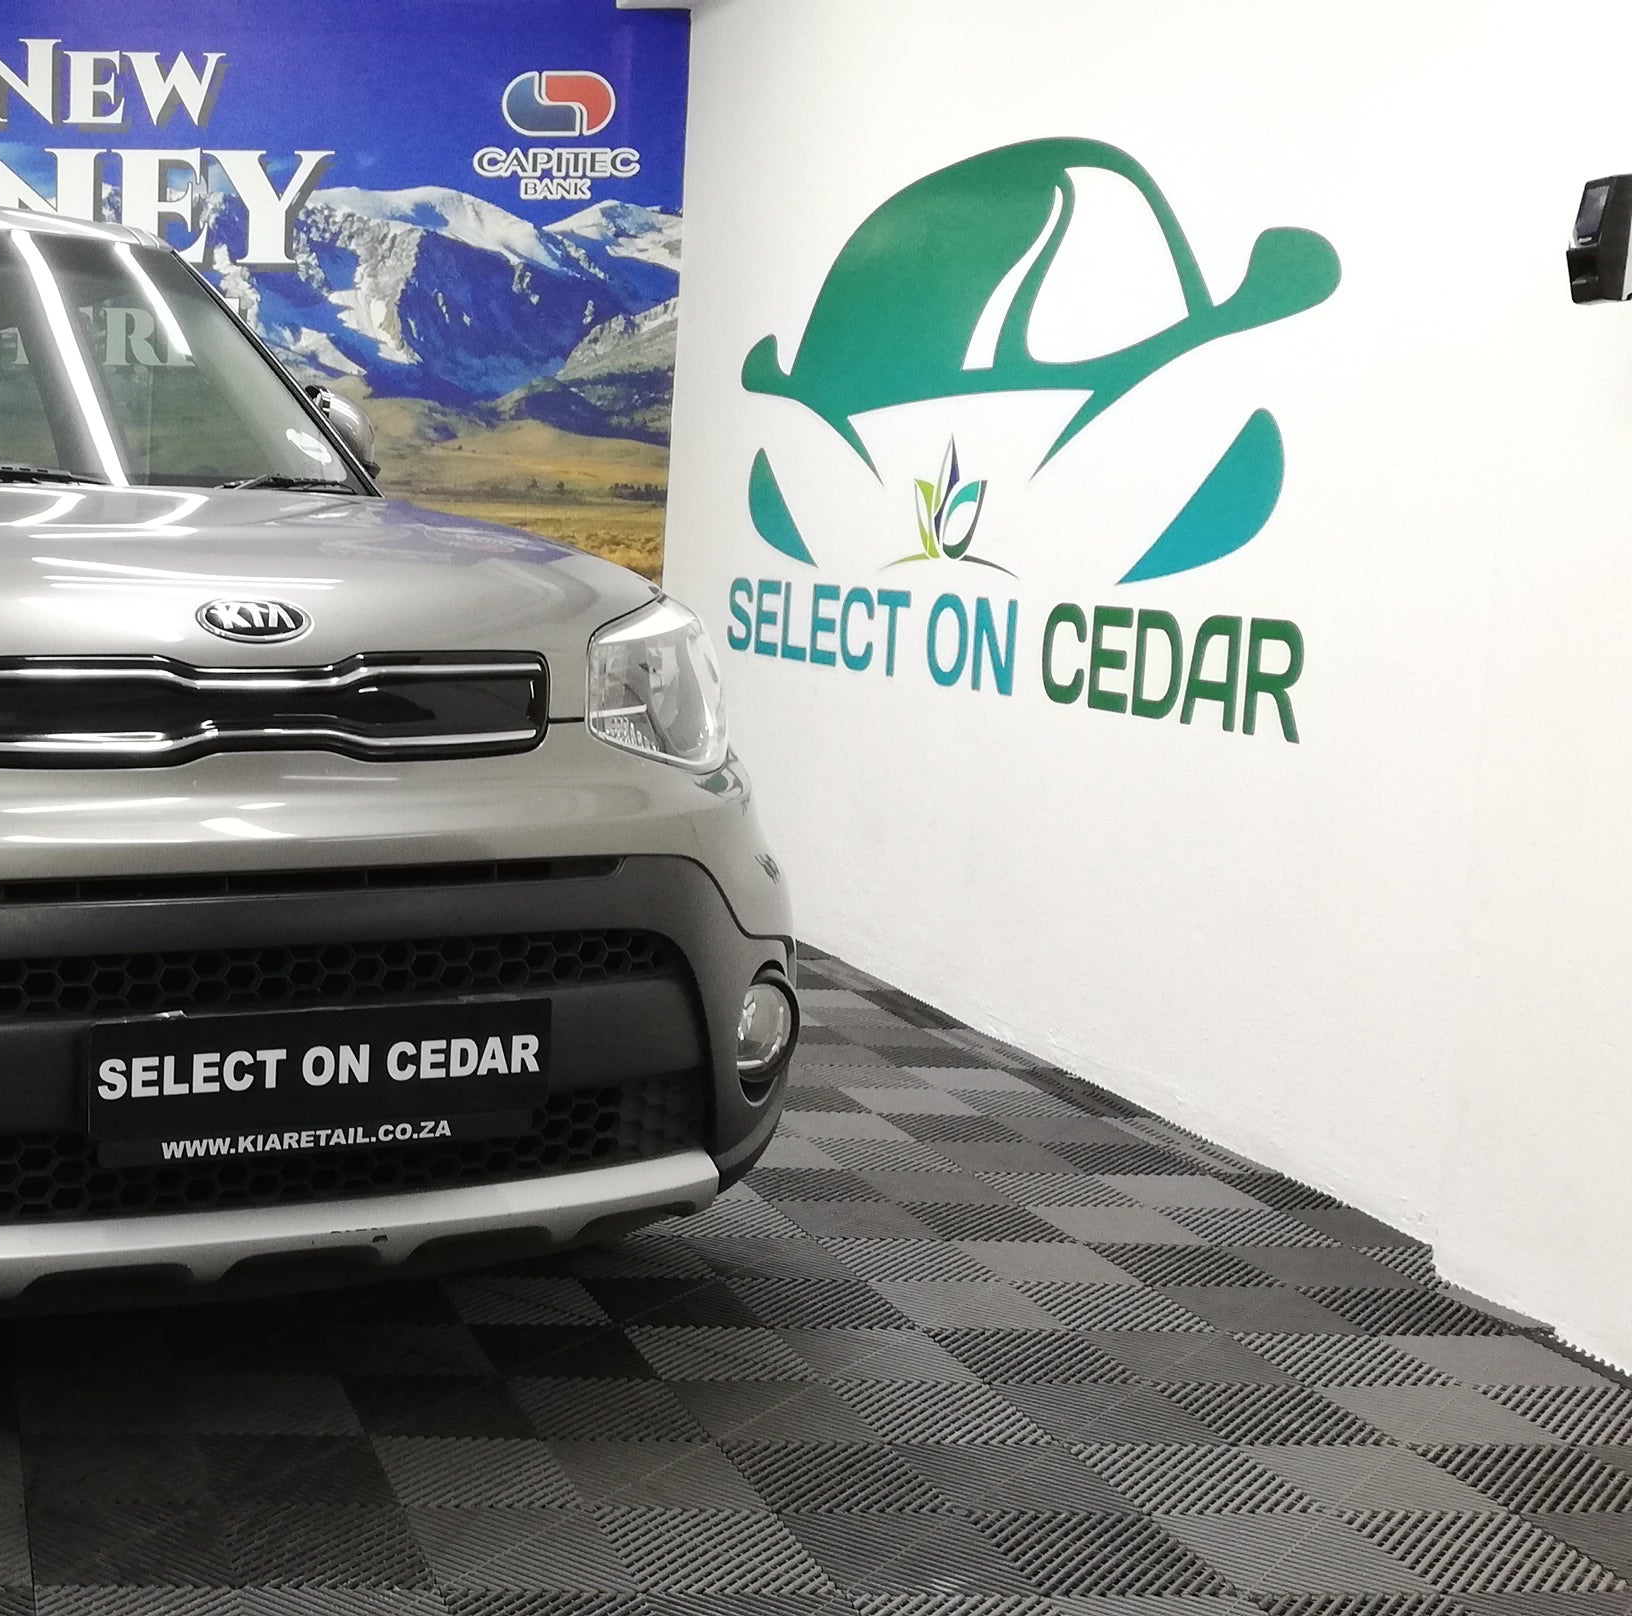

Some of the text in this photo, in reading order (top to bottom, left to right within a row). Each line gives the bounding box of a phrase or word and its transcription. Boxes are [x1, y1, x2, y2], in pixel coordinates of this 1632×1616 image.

[475, 149, 639, 176] CAPITEC
[522, 180, 589, 197] BANK
[727, 576, 1305, 743] SELECT ON CEDAR
[98, 1033, 540, 1100] SELECT ON CEDAR
[161, 1119, 451, 1160] WWW.KIARETAIL.CO.ZA
